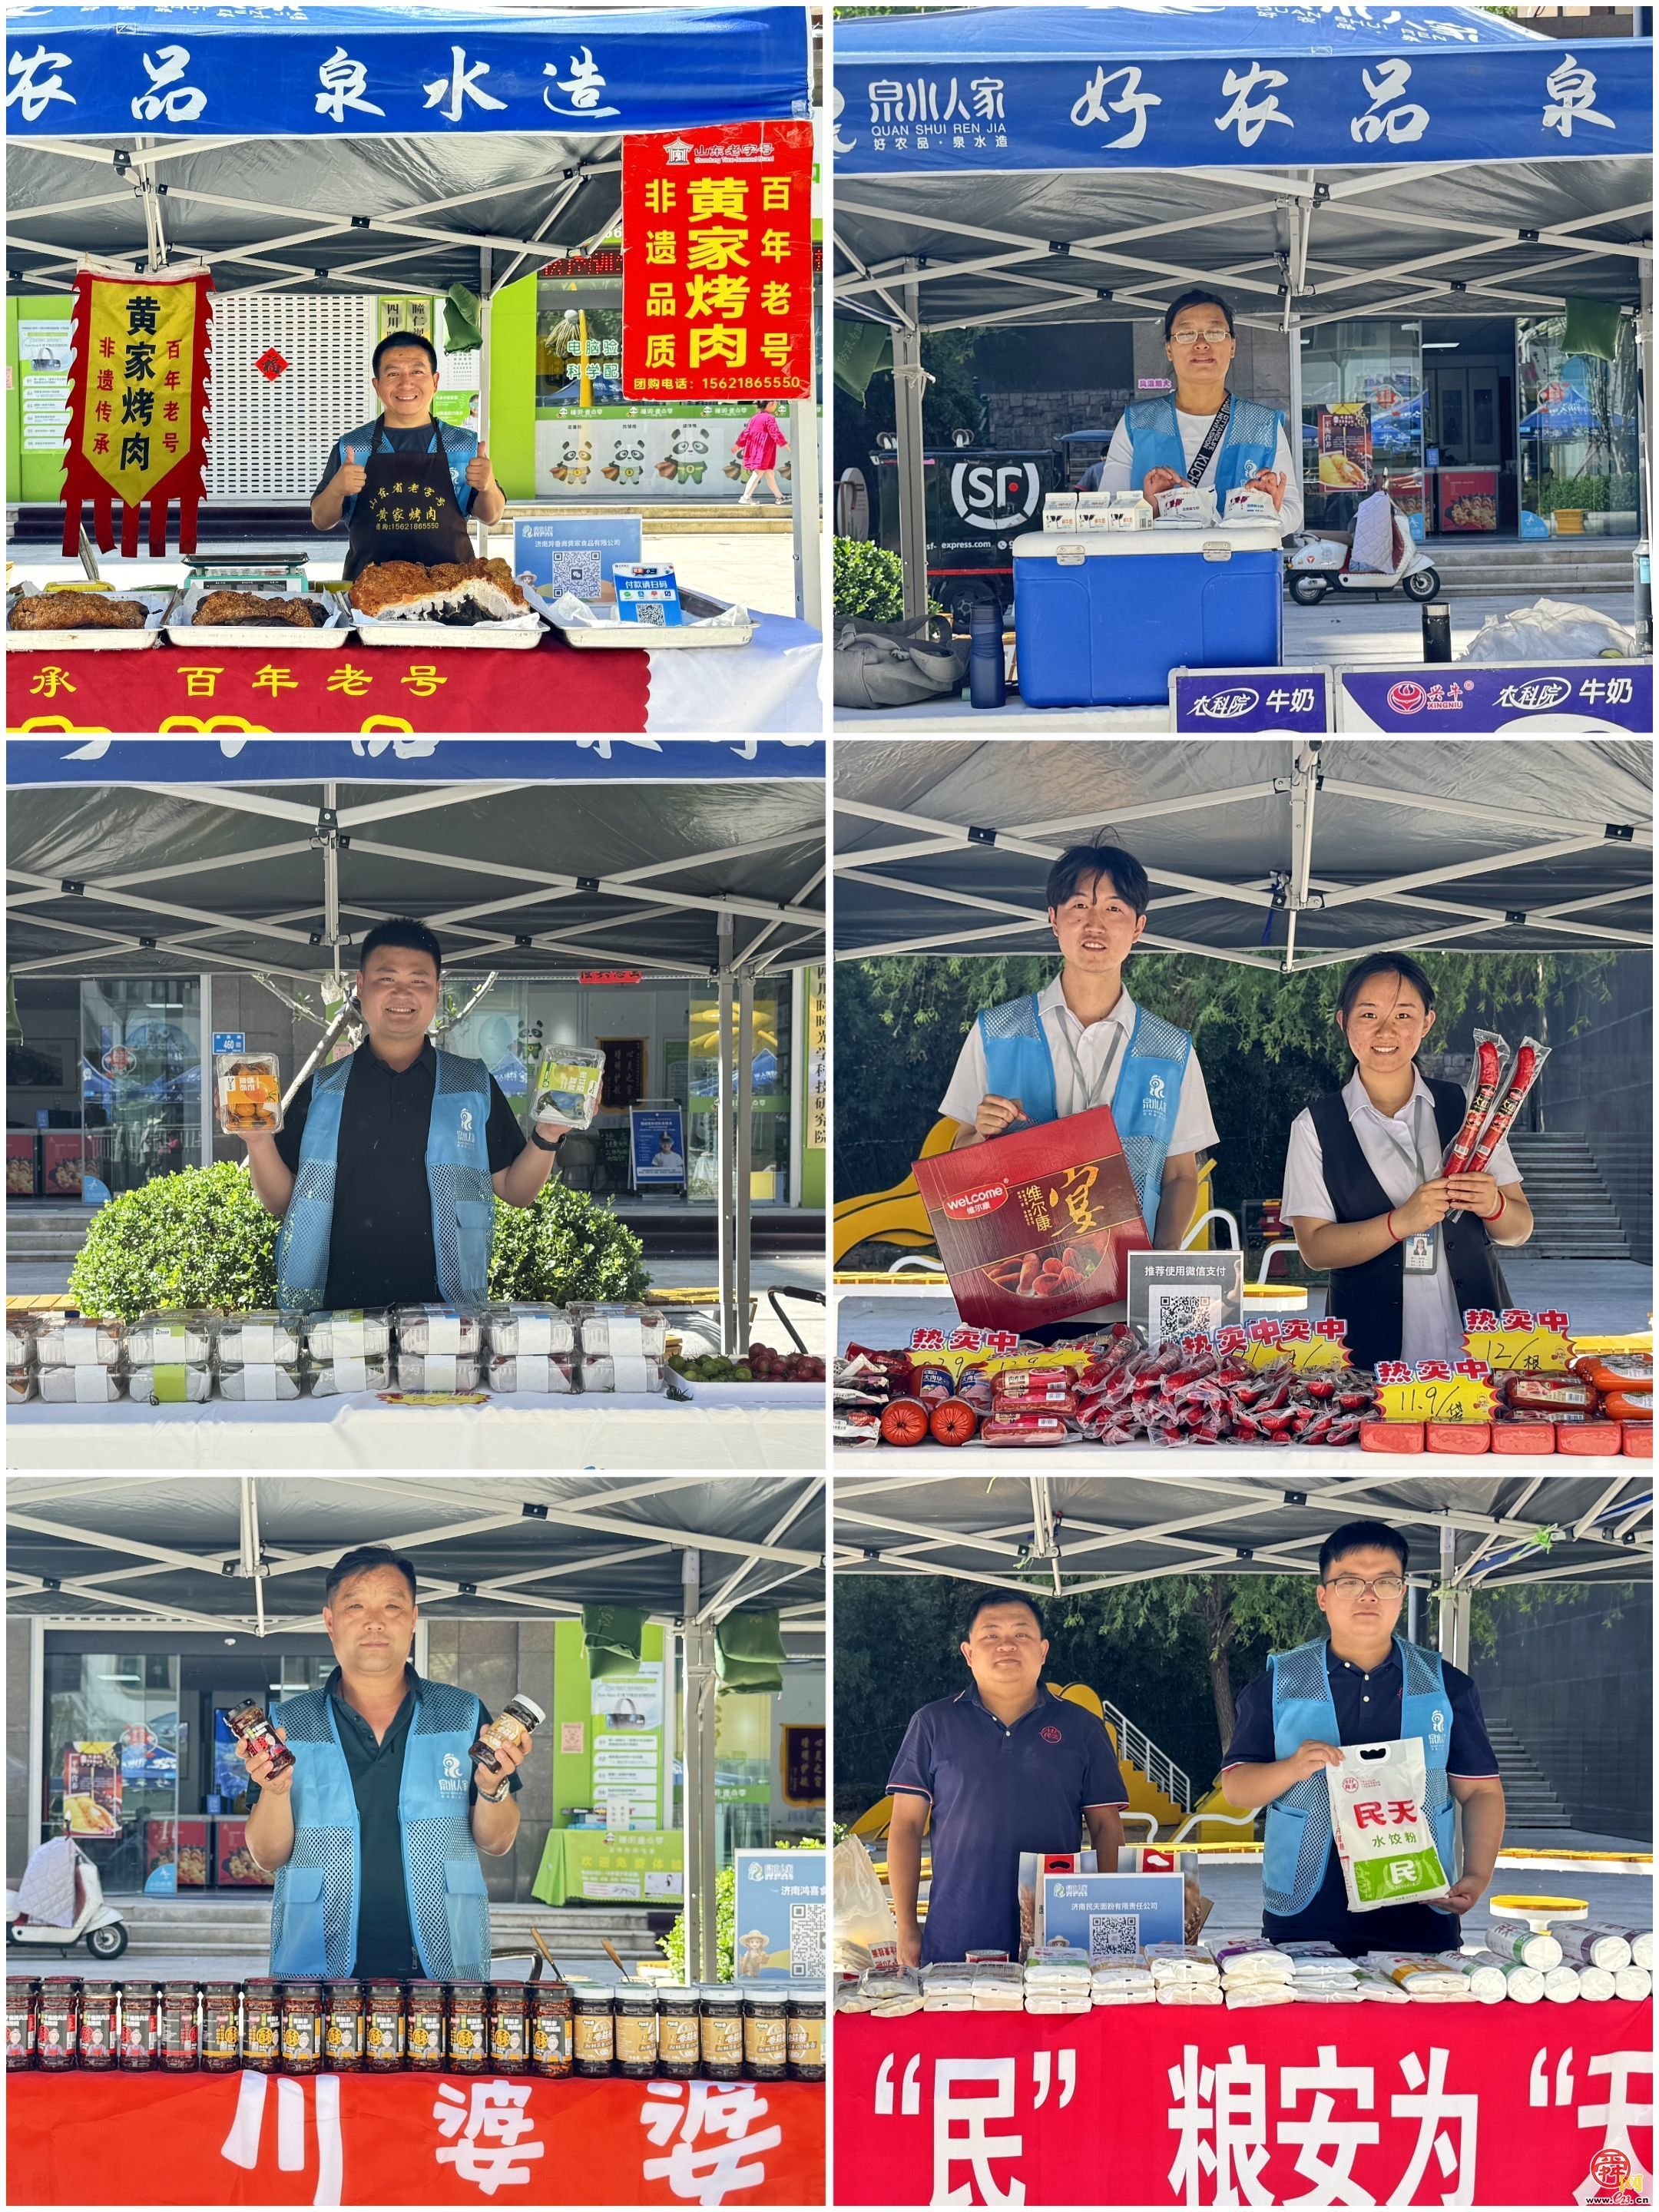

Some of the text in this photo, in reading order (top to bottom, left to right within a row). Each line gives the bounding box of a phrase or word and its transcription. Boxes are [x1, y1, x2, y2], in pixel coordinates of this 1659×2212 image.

[315, 46, 621, 122] 泉水造
[869, 76, 1005, 123] 泉水人家
[1071, 54, 1617, 149] 好农品 泉
[871, 123, 1006, 137] QUAN SHUI REN JIA
[694, 144, 774, 157] 山东老字号
[645, 179, 677, 368] 非遗品质
[685, 177, 750, 368] 黄家烤肉
[760, 177, 793, 367] 百年老号
[387, 303, 399, 336] 四川
[567, 339, 622, 356] 电脑验
[262, 356, 282, 374] 福
[567, 363, 621, 380] 科学配
[93, 336, 115, 455] 非遗传承
[120, 296, 161, 471] 黄家烤肉
[702, 376, 800, 389] 15621865550
[162, 339, 183, 454] 百年老号
[376, 507, 437, 522] 黄家烤肉
[942, 540, 992, 550] express.com
[625, 580, 668, 589] 付款请扫码
[32, 664, 448, 698] 承 百年老号
[1498, 678, 1633, 707] 农科院 牛奶
[1191, 689, 1315, 717] 农科院 牛奶
[1427, 701, 1463, 710] XINGNIU
[224, 1041, 235, 1050] 460
[966, 1202, 992, 1215] 维尔康
[1026, 1184, 1053, 1232] 维尔康
[1050, 1166, 1104, 1237] 宴
[1144, 1266, 1227, 1277] 推荐使用微信支付
[1282, 1317, 1346, 1342] 卖中
[1465, 1309, 1570, 1333] 热卖中
[910, 1327, 1019, 1353] 热卖中
[1377, 1359, 1489, 1382] 热卖中
[1353, 1799, 1418, 1830] 民天
[1372, 1831, 1417, 1849] 水饺粉
[1390, 1859, 1418, 1885] 民
[221, 2069, 781, 2205] 川婆婆
[1167, 2045, 1479, 2206] 粮安为
